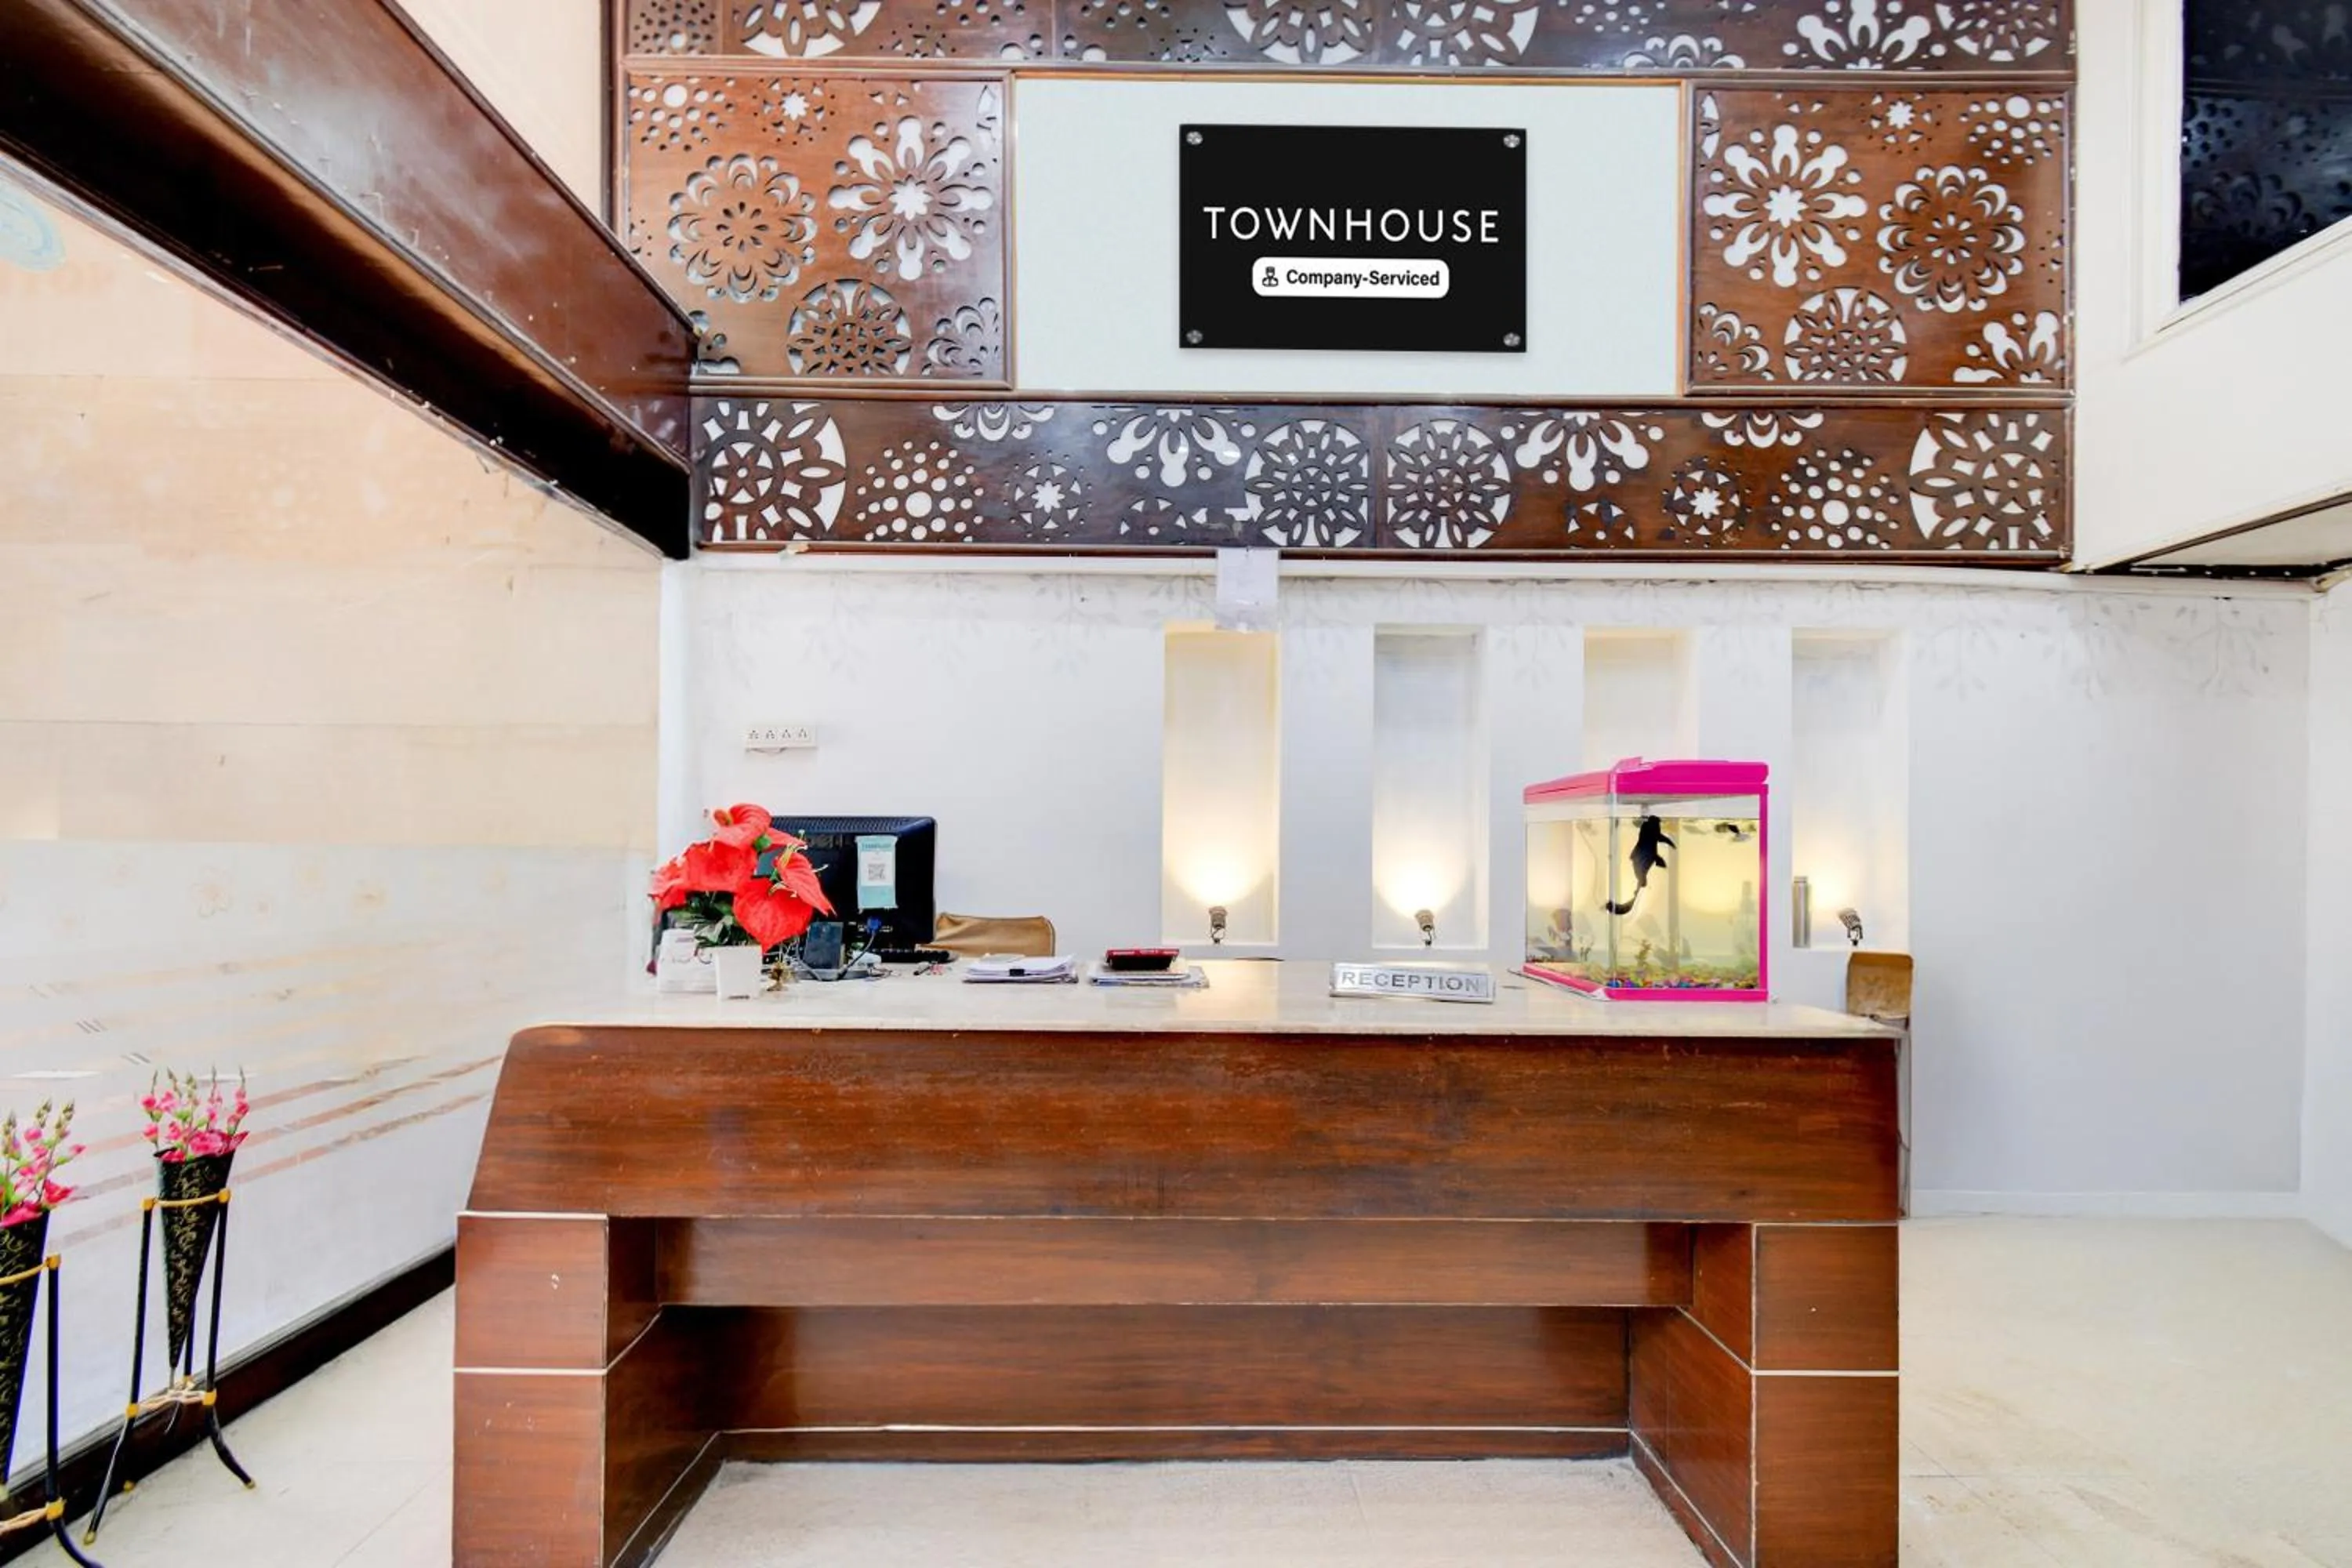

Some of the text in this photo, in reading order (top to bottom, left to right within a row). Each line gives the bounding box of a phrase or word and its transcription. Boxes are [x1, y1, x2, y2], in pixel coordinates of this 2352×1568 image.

[1203, 207, 1498, 242] TOWNHOUSE
[1287, 270, 1439, 289] Company-Serviced
[1341, 971, 1479, 992] RECEPTION
